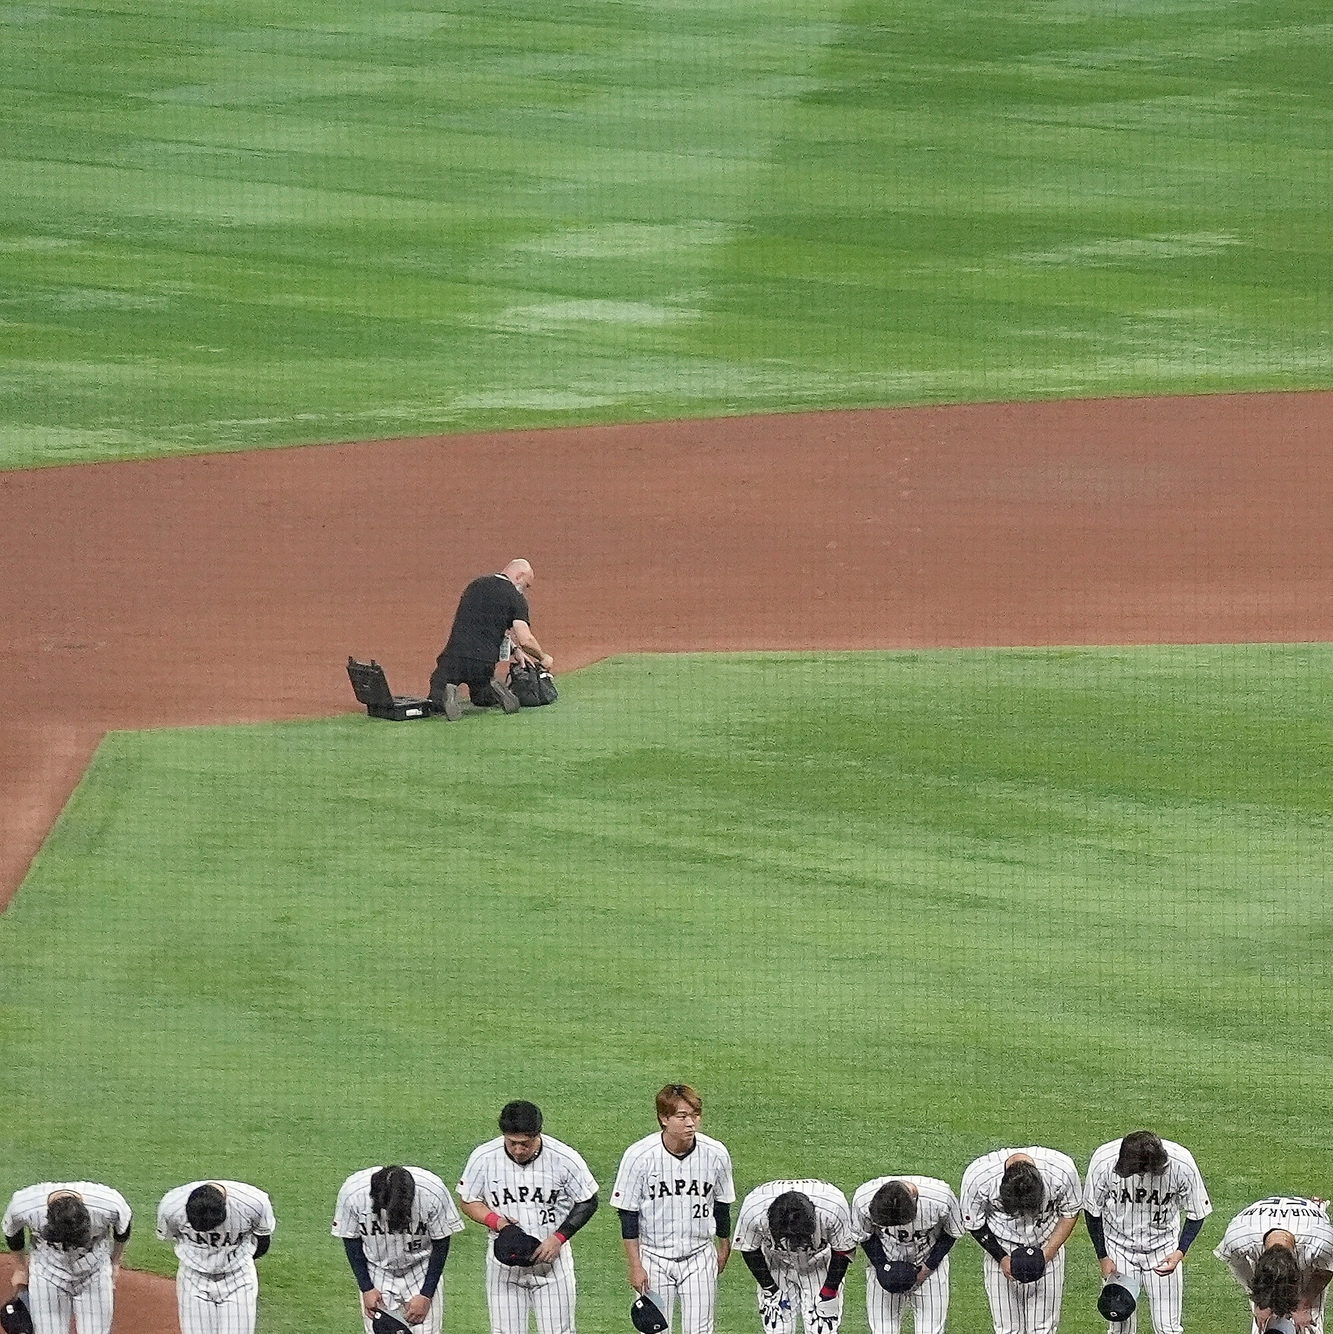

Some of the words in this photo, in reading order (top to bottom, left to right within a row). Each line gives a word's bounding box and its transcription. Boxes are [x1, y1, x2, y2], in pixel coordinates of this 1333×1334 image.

[491, 1186, 561, 1207] JAPAN
[540, 1208, 556, 1225] 25
[359, 1220, 428, 1236] JAN
